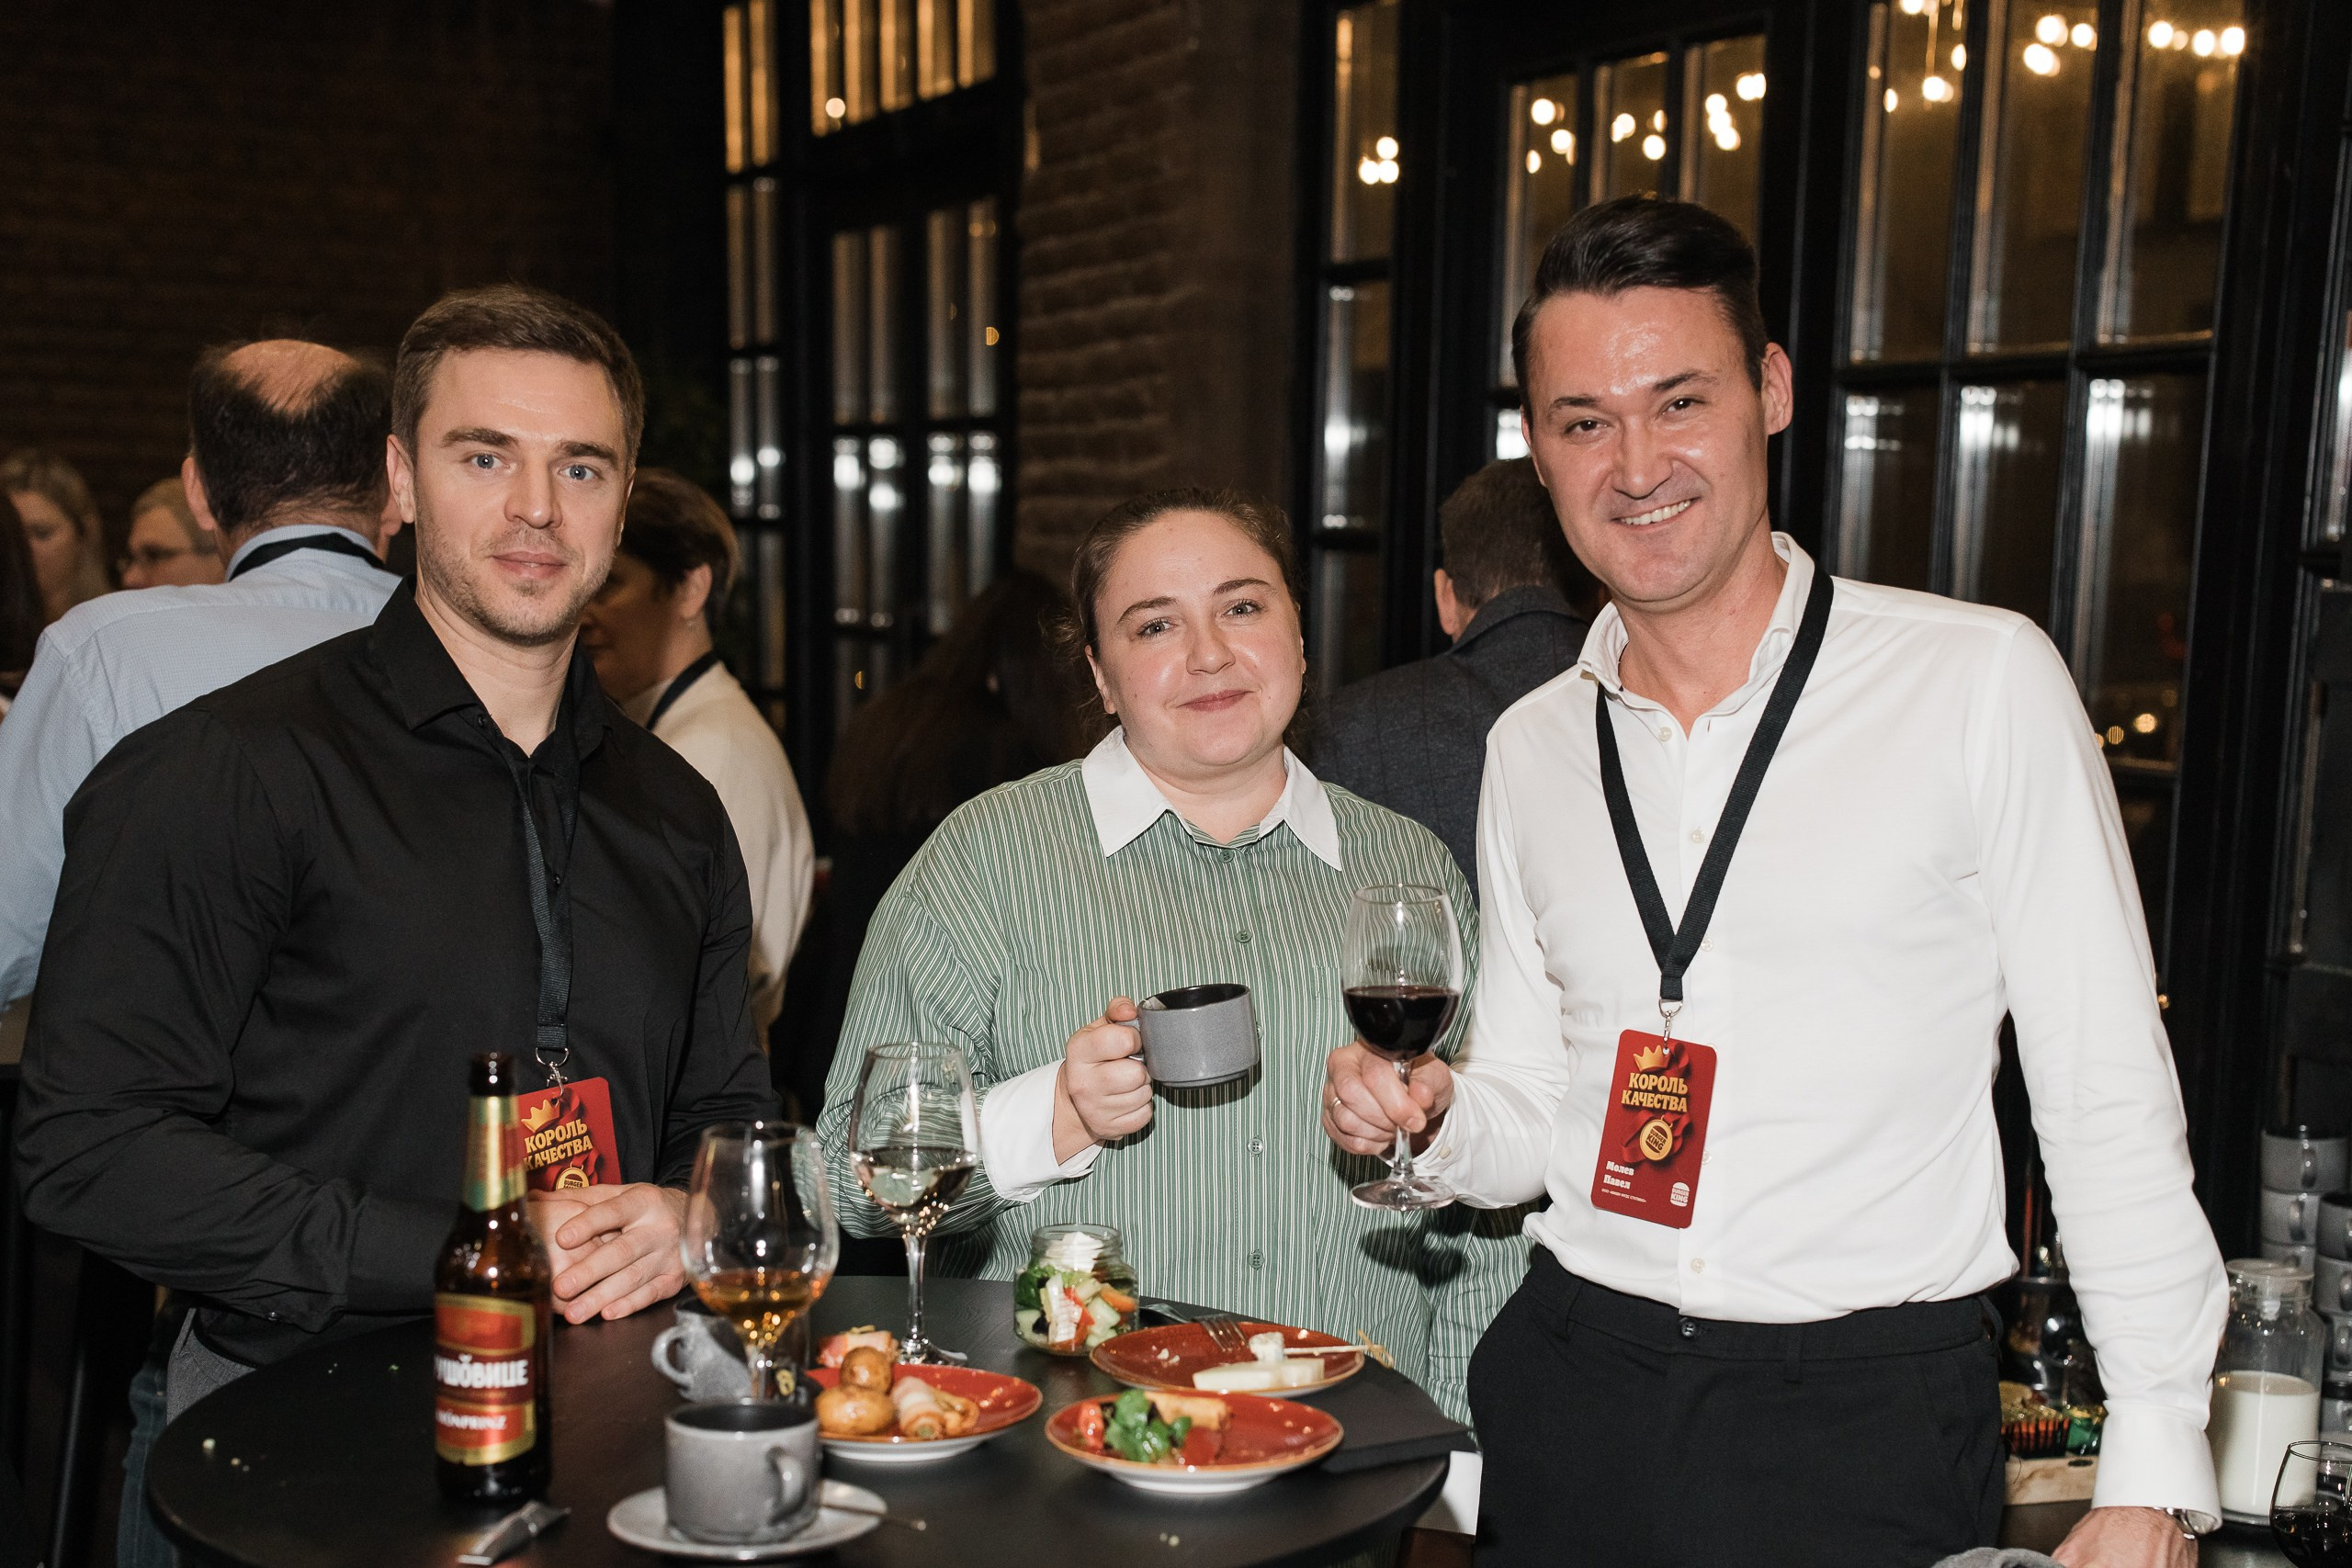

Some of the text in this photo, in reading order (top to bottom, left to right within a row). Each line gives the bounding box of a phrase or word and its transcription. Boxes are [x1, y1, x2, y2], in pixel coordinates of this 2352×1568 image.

[1628, 1072, 1688, 1095] КОРОЛЬ
[1622, 1089, 1688, 1112] КАЧЕСТВА
[524, 1119, 588, 1154] КОРОЛЬ
[1646, 1133, 1664, 1150] KING
[1650, 1128, 1667, 1145] BURGER
[523, 1135, 594, 1170] КАЧЕСТВА
[1606, 1160, 1634, 1176] Молев
[1603, 1174, 1631, 1189] Павел
[1670, 1192, 1689, 1203] KING
